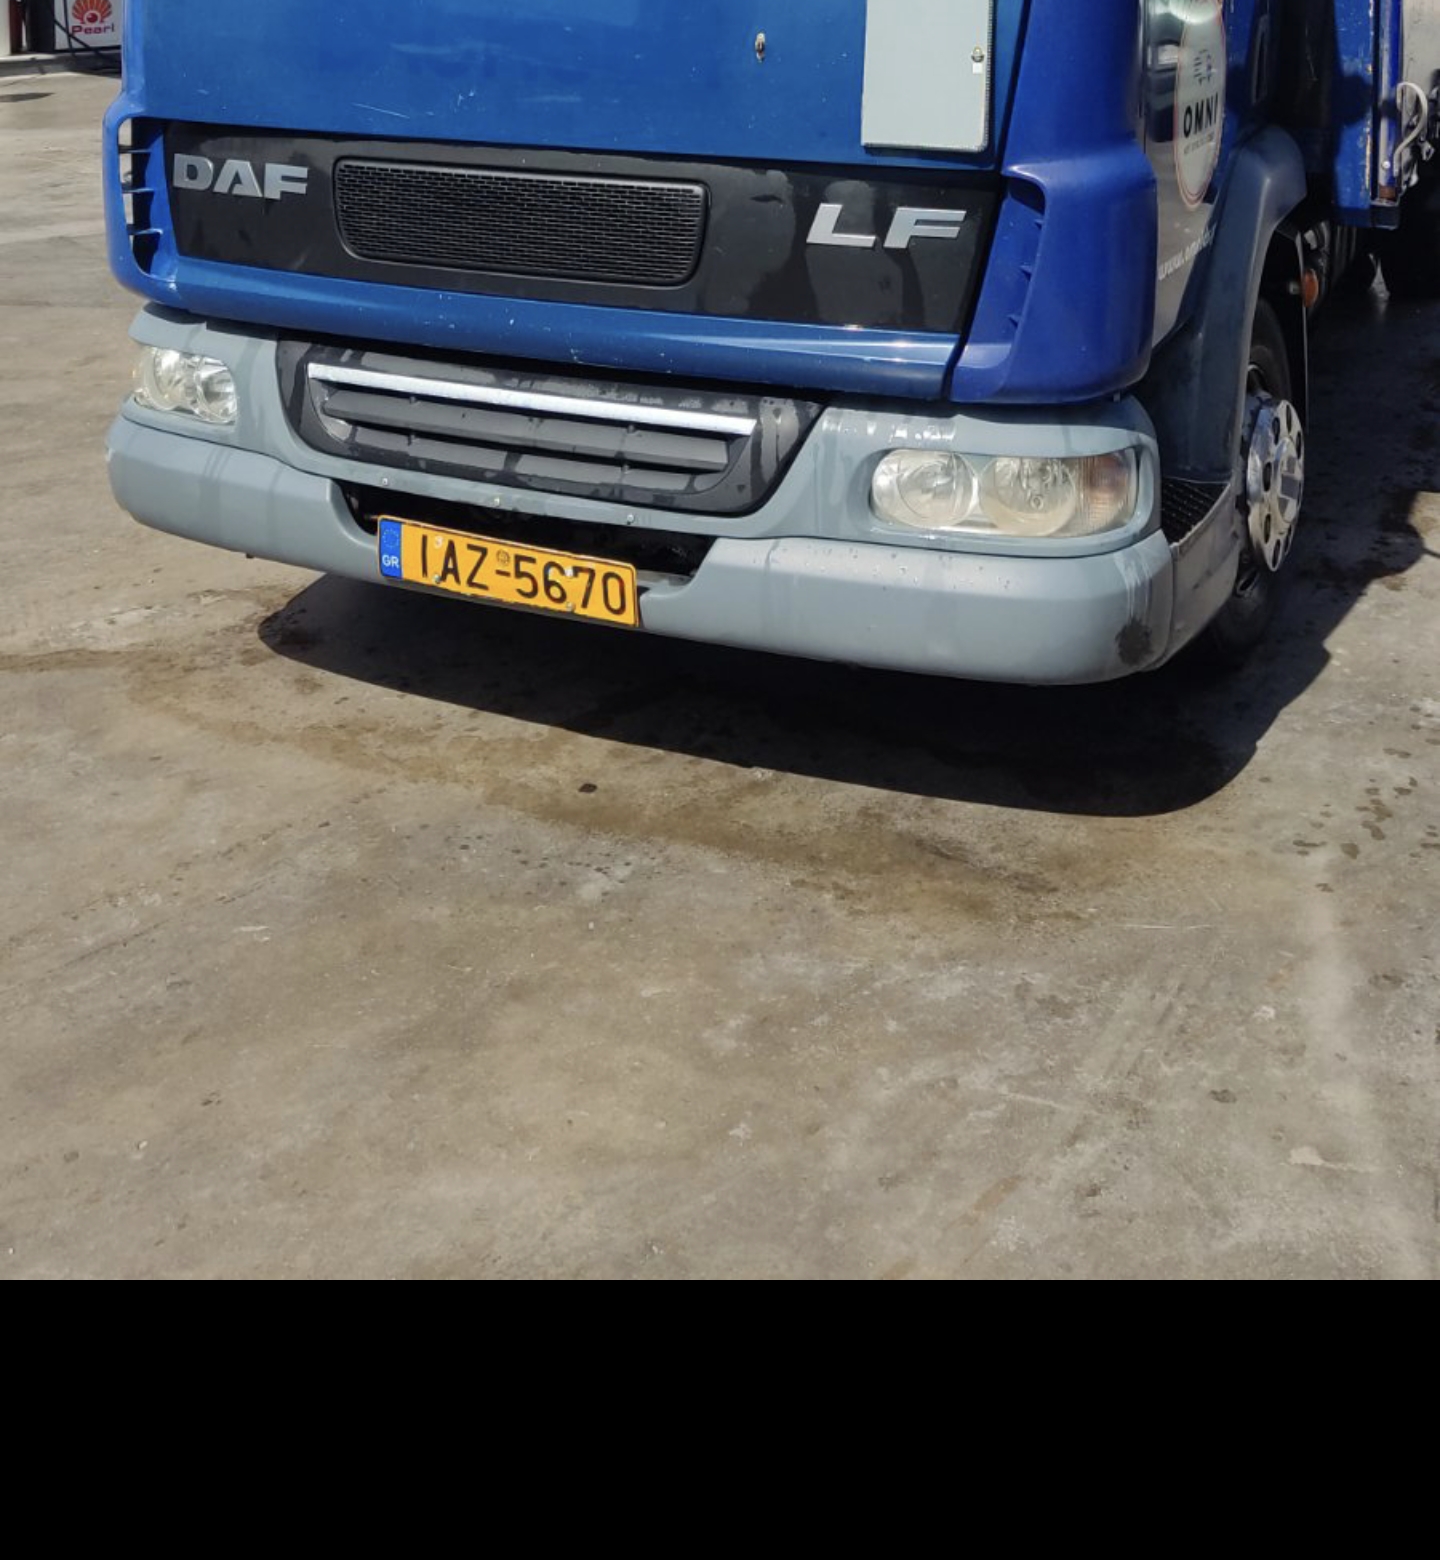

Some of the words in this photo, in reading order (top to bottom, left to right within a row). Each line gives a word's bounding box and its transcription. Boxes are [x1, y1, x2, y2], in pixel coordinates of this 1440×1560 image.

[71, 22, 115, 36] Pearl
[1183, 91, 1219, 139] OMNI
[172, 153, 308, 201] DAF
[806, 202, 968, 249] LF
[381, 553, 400, 570] GR
